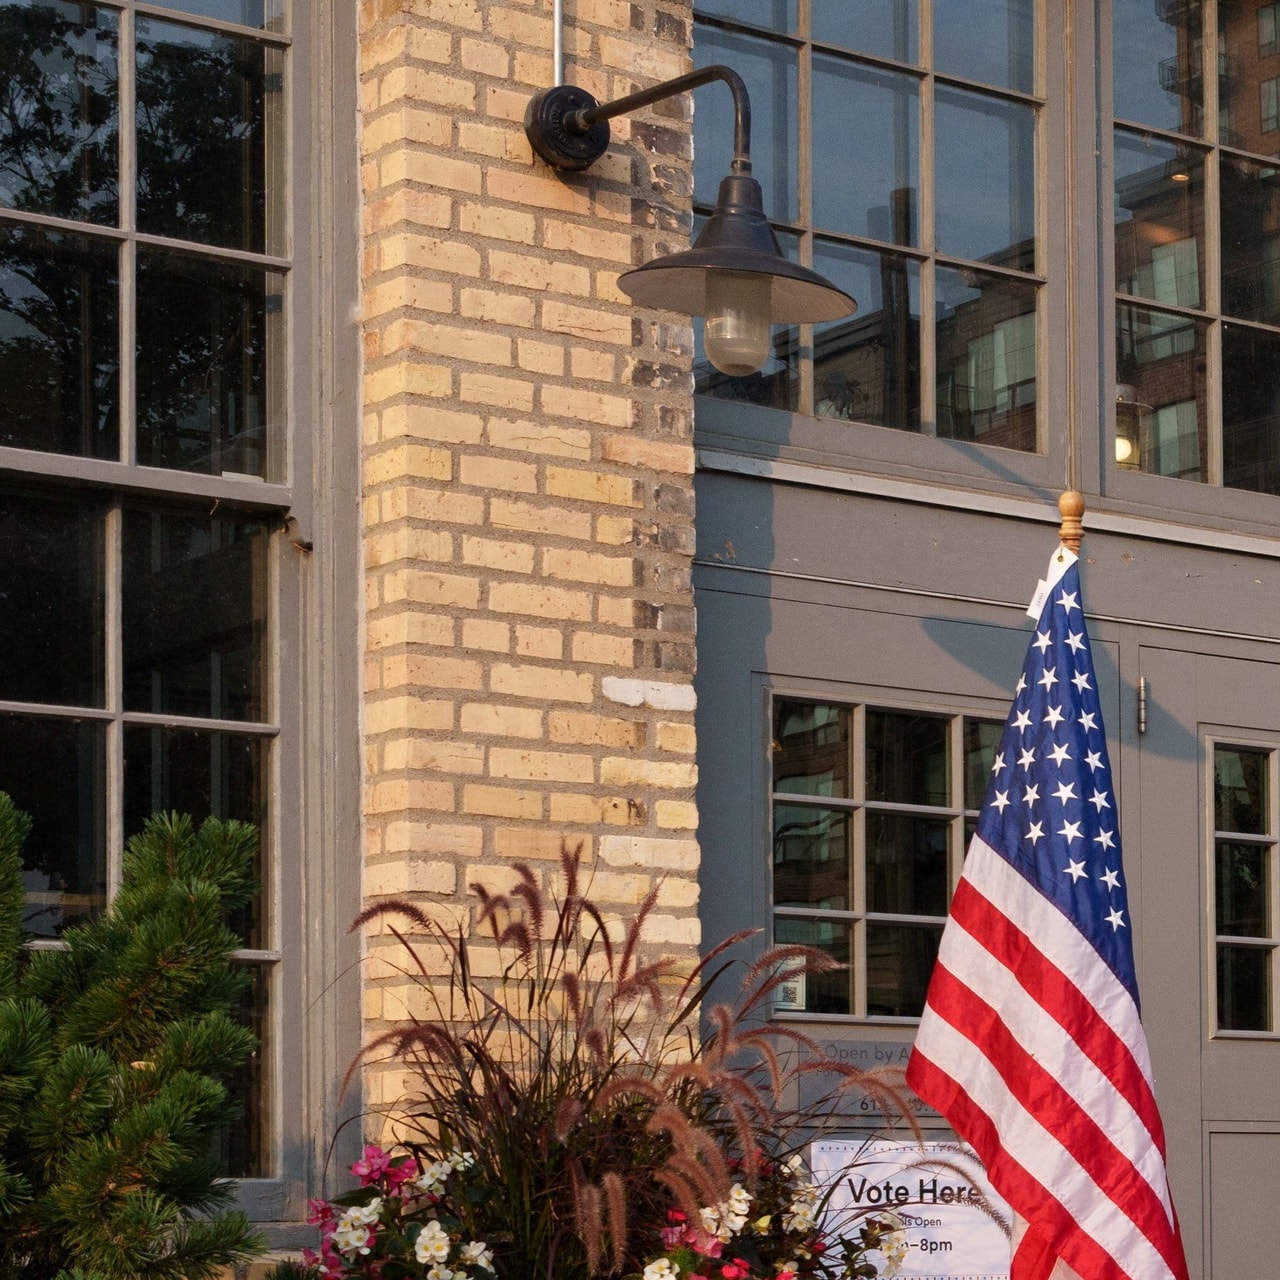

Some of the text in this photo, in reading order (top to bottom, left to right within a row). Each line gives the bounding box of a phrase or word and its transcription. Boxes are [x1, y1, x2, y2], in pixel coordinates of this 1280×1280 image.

[825, 1044, 868, 1062] Open
[874, 1044, 893, 1064] by
[847, 1178, 910, 1204] Vote
[914, 1216, 942, 1228] Open
